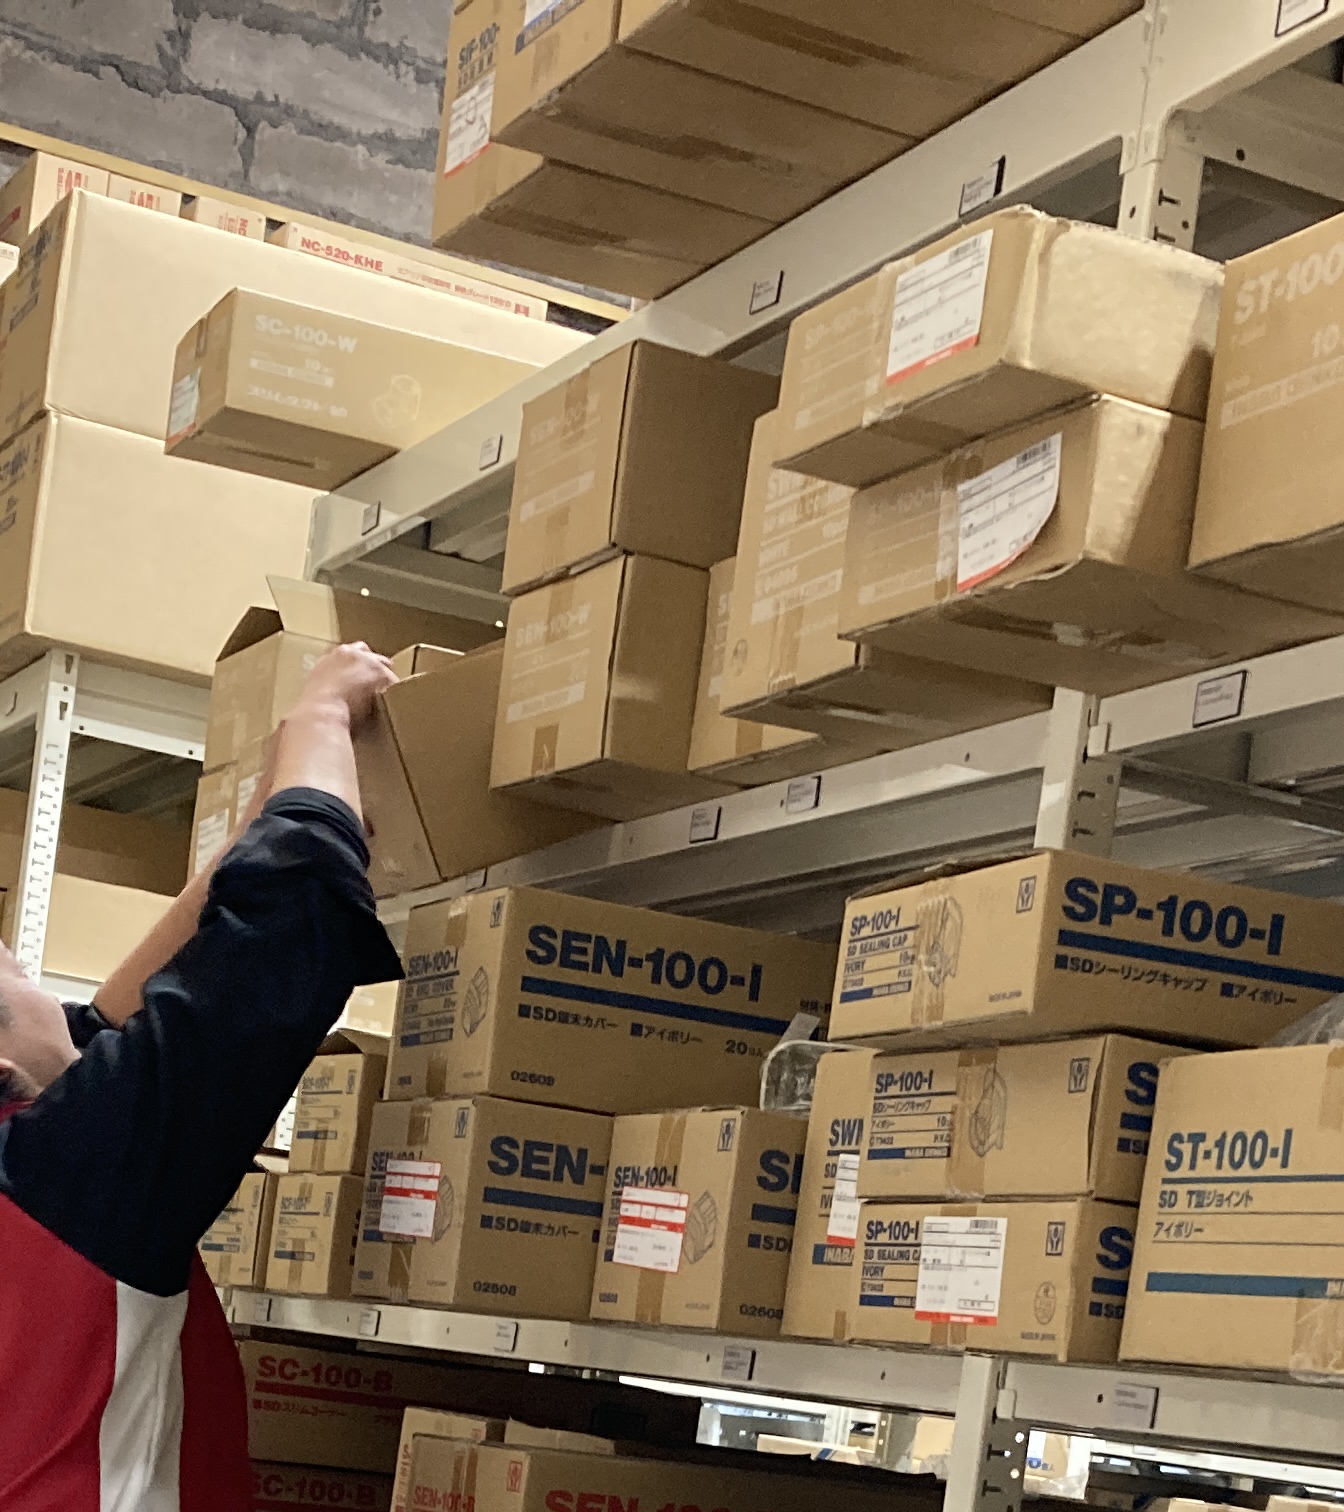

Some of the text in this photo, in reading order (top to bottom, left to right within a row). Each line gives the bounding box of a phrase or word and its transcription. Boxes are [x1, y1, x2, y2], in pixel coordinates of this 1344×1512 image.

[300, 237, 383, 272] NC-520-KHE
[255, 315, 357, 353] SC-100-W
[850, 907, 900, 937] SP-100-I
[1061, 877, 1286, 956] SP-100-I
[524, 924, 763, 1001] SEN-100-I
[875, 1070, 933, 1094] SP-100-I
[1164, 1129, 1294, 1172] ST-100-I
[866, 1219, 919, 1241] SP-100-I
[257, 1355, 394, 1394] SC-100-B
